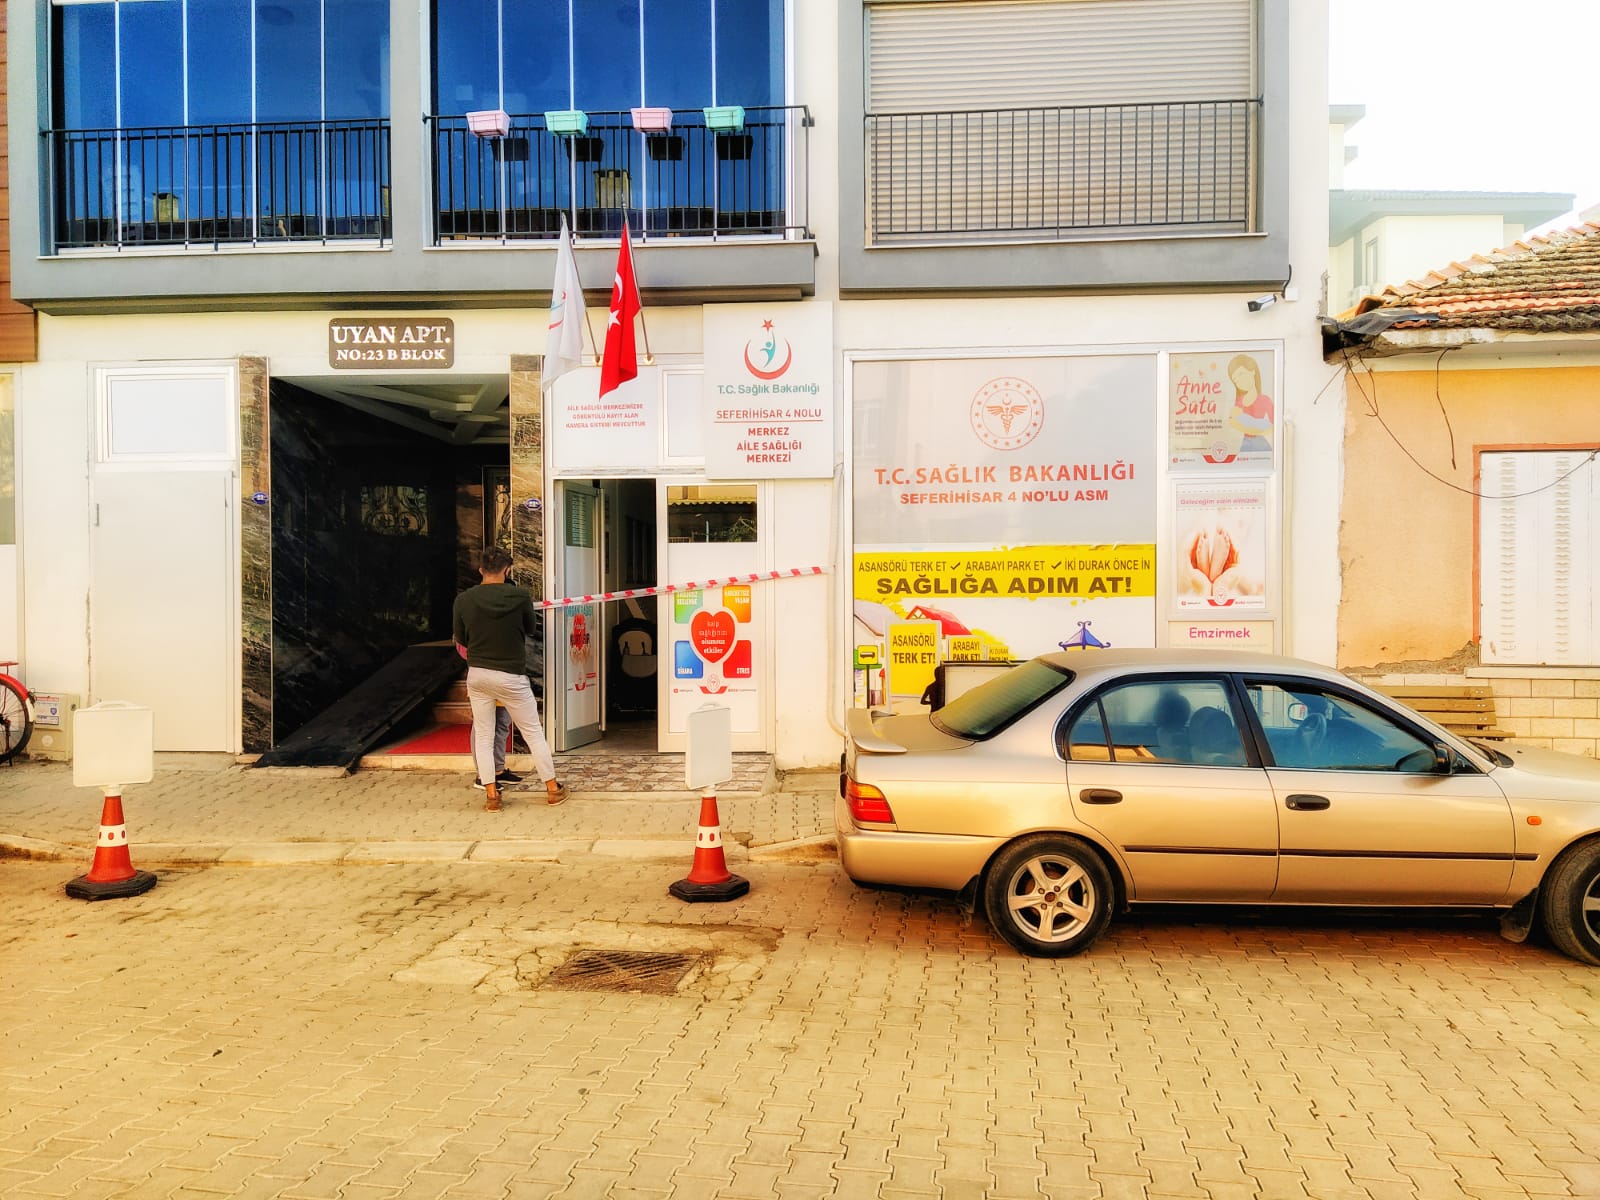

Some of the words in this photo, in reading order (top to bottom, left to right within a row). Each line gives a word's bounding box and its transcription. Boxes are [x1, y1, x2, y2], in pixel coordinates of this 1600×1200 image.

[331, 325, 397, 344] UYAN
[400, 325, 451, 344] APT.
[336, 349, 384, 361] NO:23
[387, 349, 398, 361] B
[400, 348, 446, 361] BLOK
[717, 384, 737, 395] T.C.
[738, 384, 770, 397] Sağlık
[772, 382, 820, 396] Bakanlığı
[1176, 375, 1222, 395] Anne
[716, 408, 783, 419] SEFERİHİSAR
[785, 409, 792, 418] 4
[793, 408, 822, 418] NOLU
[748, 427, 790, 437] MERKEZ
[736, 439, 760, 451] AİLE
[762, 438, 802, 451] SAĞLIĞI
[746, 452, 791, 463] MERKEZİ
[874, 468, 911, 485] T.C.
[915, 463, 997, 484] SAĞLIK
[1009, 459, 1135, 482] BAKANLIĞI
[900, 489, 1003, 504] SEFERİHİSAR
[1007, 491, 1017, 503] 4
[1022, 490, 1069, 502] NO'LU
[1074, 489, 1109, 501] ASM
[858, 560, 908, 573] ASANSÖRÜ
[910, 561, 932, 572] TERK
[934, 561, 947, 572] ET
[965, 560, 1005, 571] ARABAYI
[1007, 560, 1031, 571] PARK
[1033, 560, 1045, 571] ET
[1064, 558, 1076, 570] İKİ
[1078, 559, 1111, 570] DURAK
[1112, 558, 1139, 570] ÖNCE
[1141, 557, 1150, 570] İN
[876, 573, 999, 595] SAĞLIĞA
[1007, 577, 1079, 594] ADIM
[1088, 577, 1132, 593] AT!
[1189, 627, 1250, 638] Emzirmek
[892, 632, 935, 647] ASANSÖRÜ
[953, 641, 980, 651] ARABAYI
[893, 652, 919, 664] TERK
[921, 652, 936, 664] ET!
[953, 653, 969, 661] PARK
